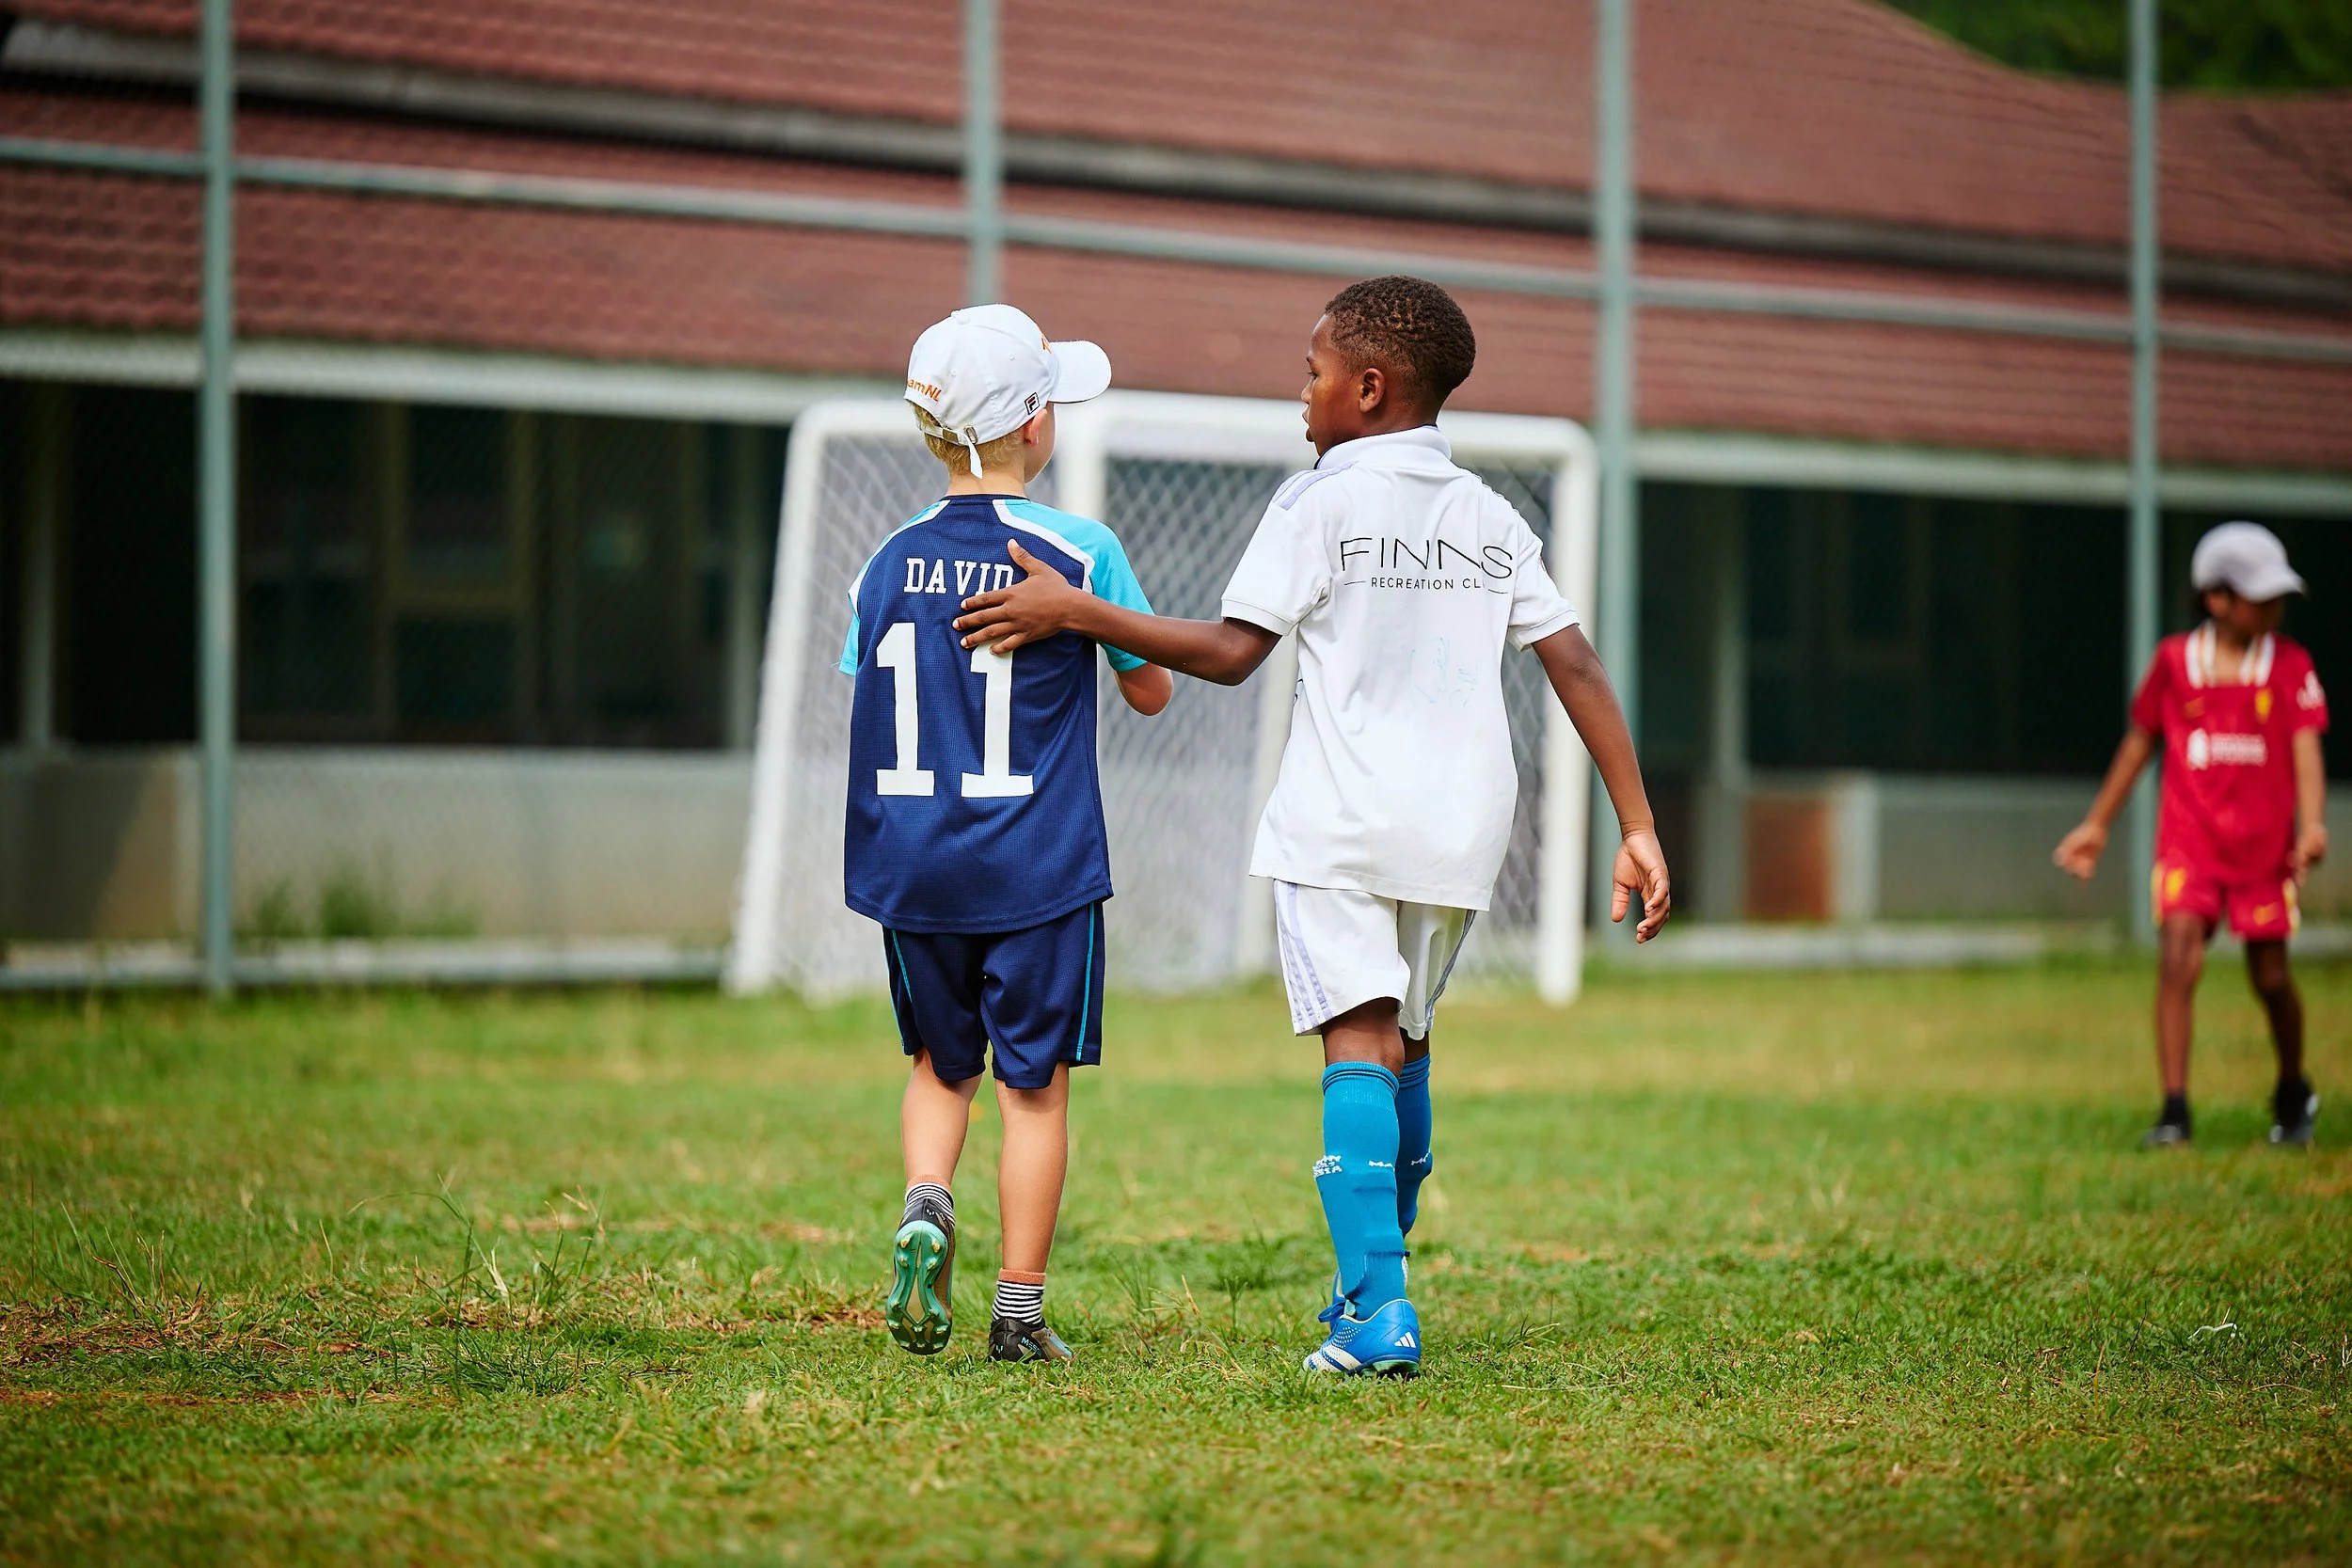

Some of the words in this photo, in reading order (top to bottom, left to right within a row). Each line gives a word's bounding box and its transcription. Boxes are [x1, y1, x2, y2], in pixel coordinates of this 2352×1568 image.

[907, 379, 942, 403] amNL
[903, 558, 1014, 596] DAVID
[1340, 537, 1513, 579] FINNS
[1371, 577, 1454, 590] RECREATION
[876, 622, 1034, 798] 11
